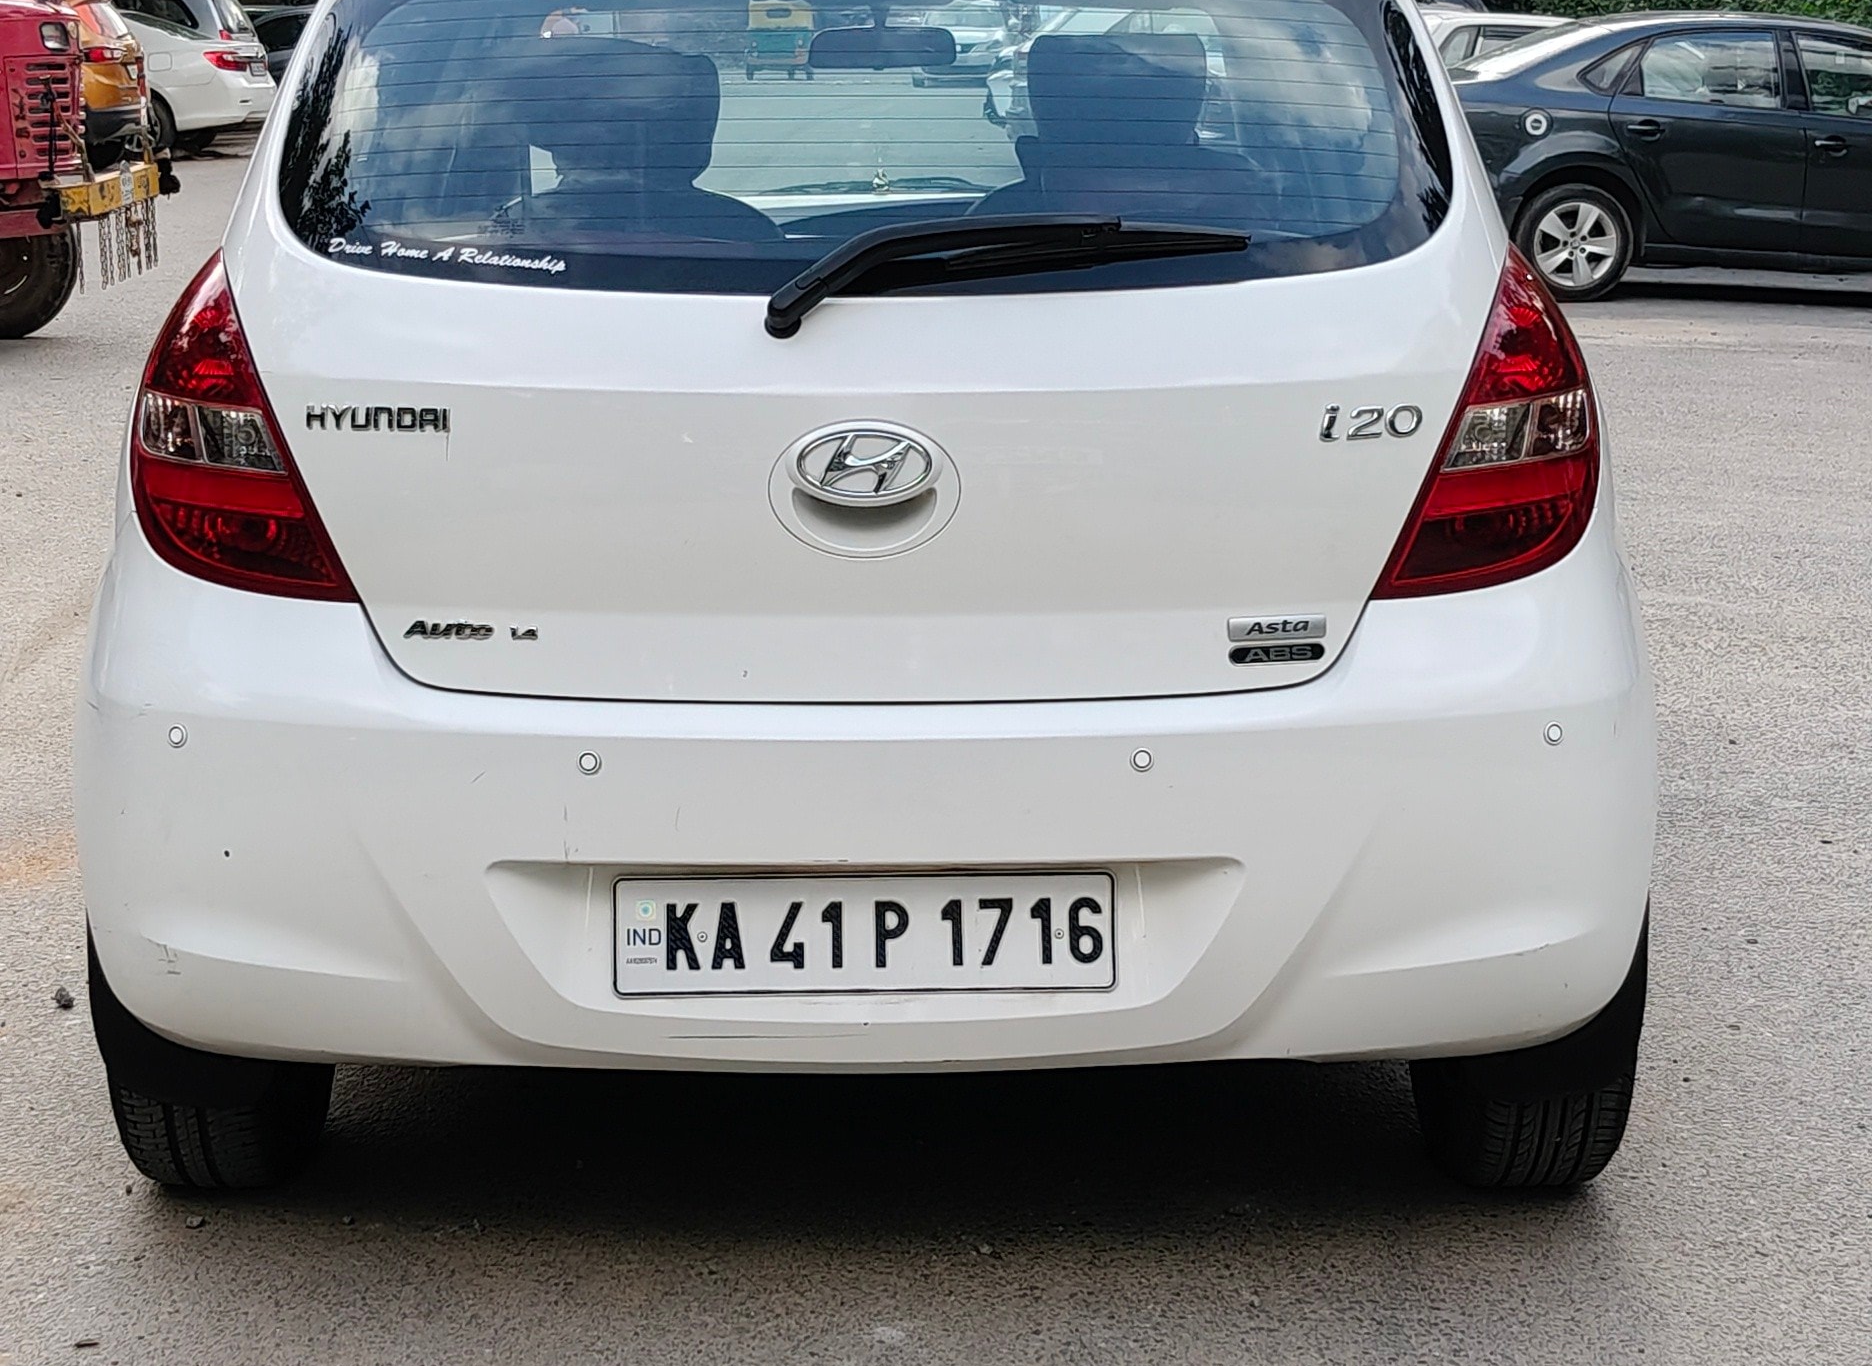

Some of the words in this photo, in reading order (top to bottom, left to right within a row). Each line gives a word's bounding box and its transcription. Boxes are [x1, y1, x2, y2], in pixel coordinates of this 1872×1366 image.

[328, 237, 372, 255] Drive
[380, 239, 428, 260] Home
[432, 246, 455, 262] A
[457, 247, 567, 273] Relationship
[306, 404, 450, 432] HYUNDAI
[1319, 402, 1423, 442] i20
[1245, 618, 1310, 636] Asta
[1244, 644, 1312, 663] ABS
[626, 928, 662, 946] IND
[665, 902, 746, 971] KA
[770, 900, 843, 970] 41
[874, 900, 909, 969] P
[940, 896, 1104, 966] 1716
